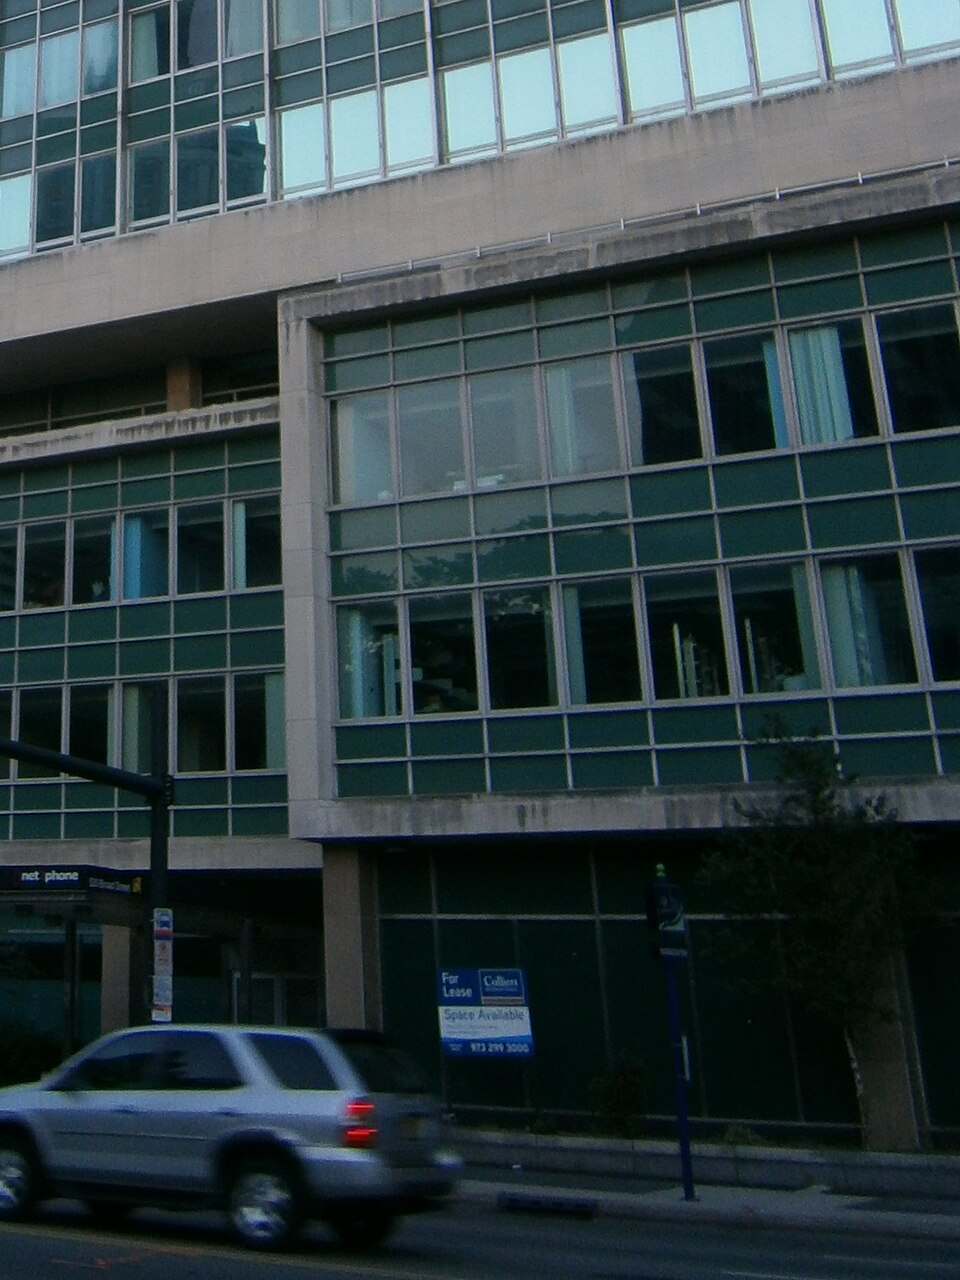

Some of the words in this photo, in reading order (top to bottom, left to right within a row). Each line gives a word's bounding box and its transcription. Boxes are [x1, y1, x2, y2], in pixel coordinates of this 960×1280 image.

[441, 972, 459, 984] For
[442, 985, 473, 998] Lease
[444, 1008, 475, 1022] Space
[478, 1008, 526, 1021] Available
[470, 1042, 487, 1052] 973
